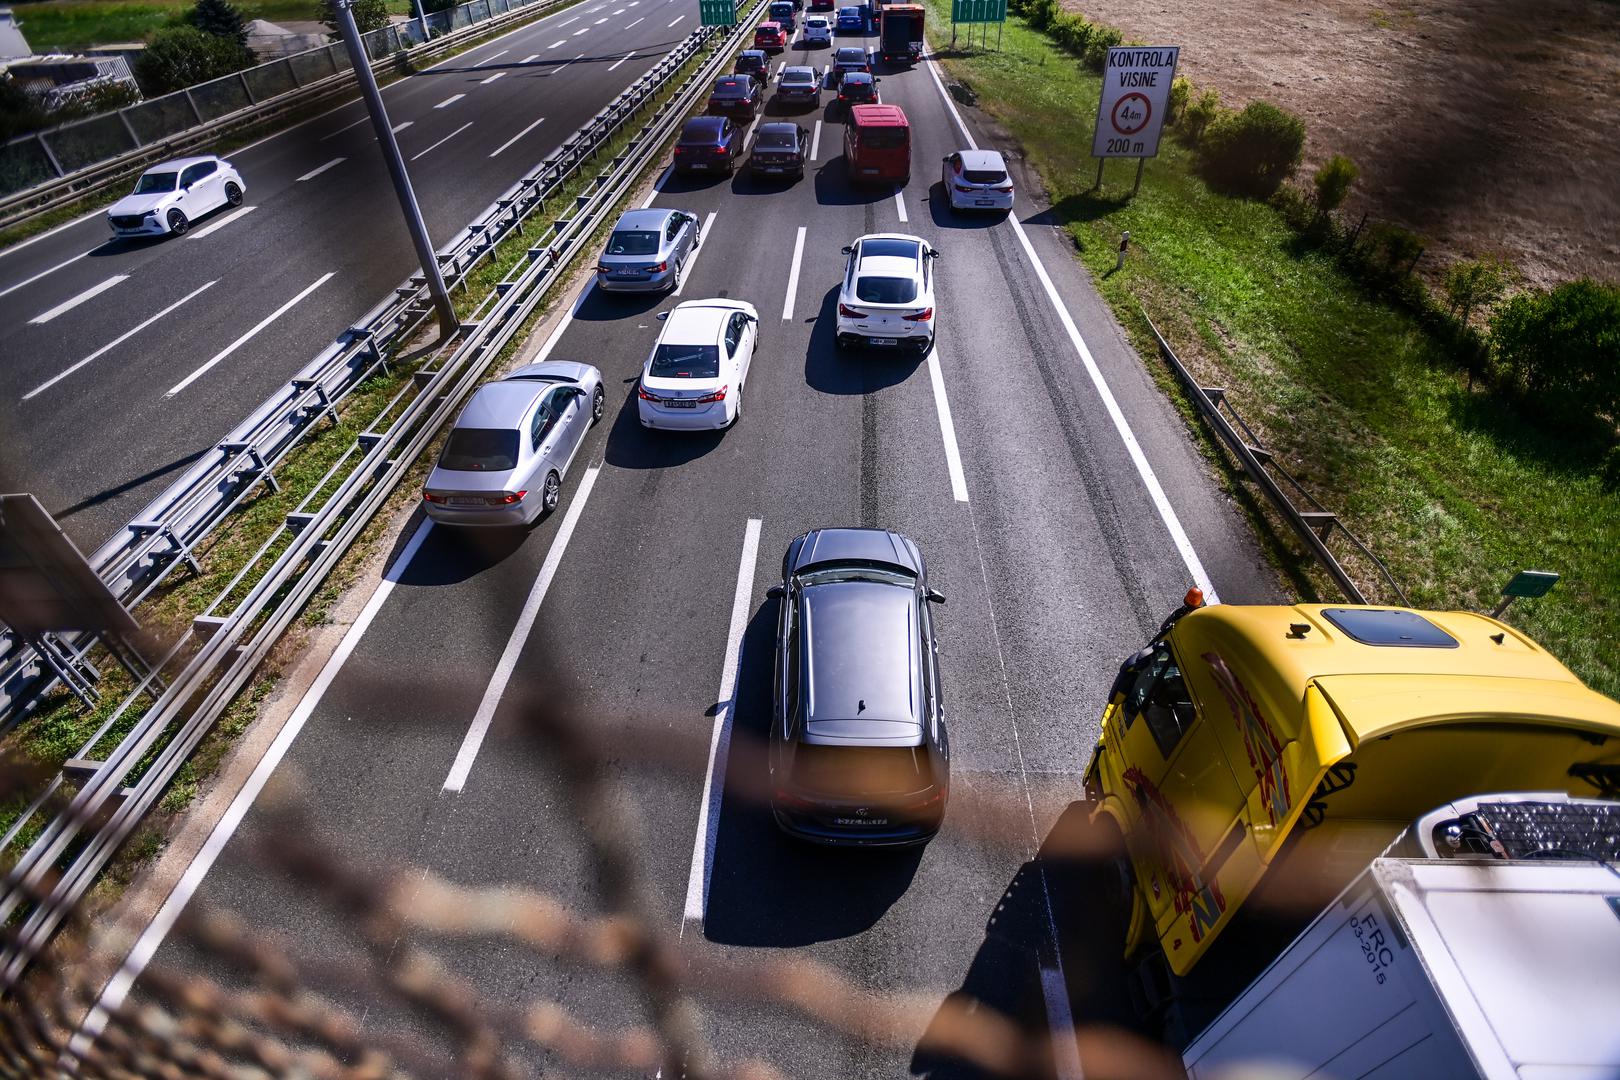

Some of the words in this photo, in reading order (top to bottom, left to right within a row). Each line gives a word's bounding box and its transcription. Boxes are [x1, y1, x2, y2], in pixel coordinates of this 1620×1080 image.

[1109, 51, 1173, 67] KONTROLA
[1120, 72, 1158, 87] VISINE
[1106, 139, 1130, 153] 200
[1133, 142, 1144, 153] m
[1361, 913, 1393, 967] FRC
[1350, 917, 1387, 984] 03-2015
